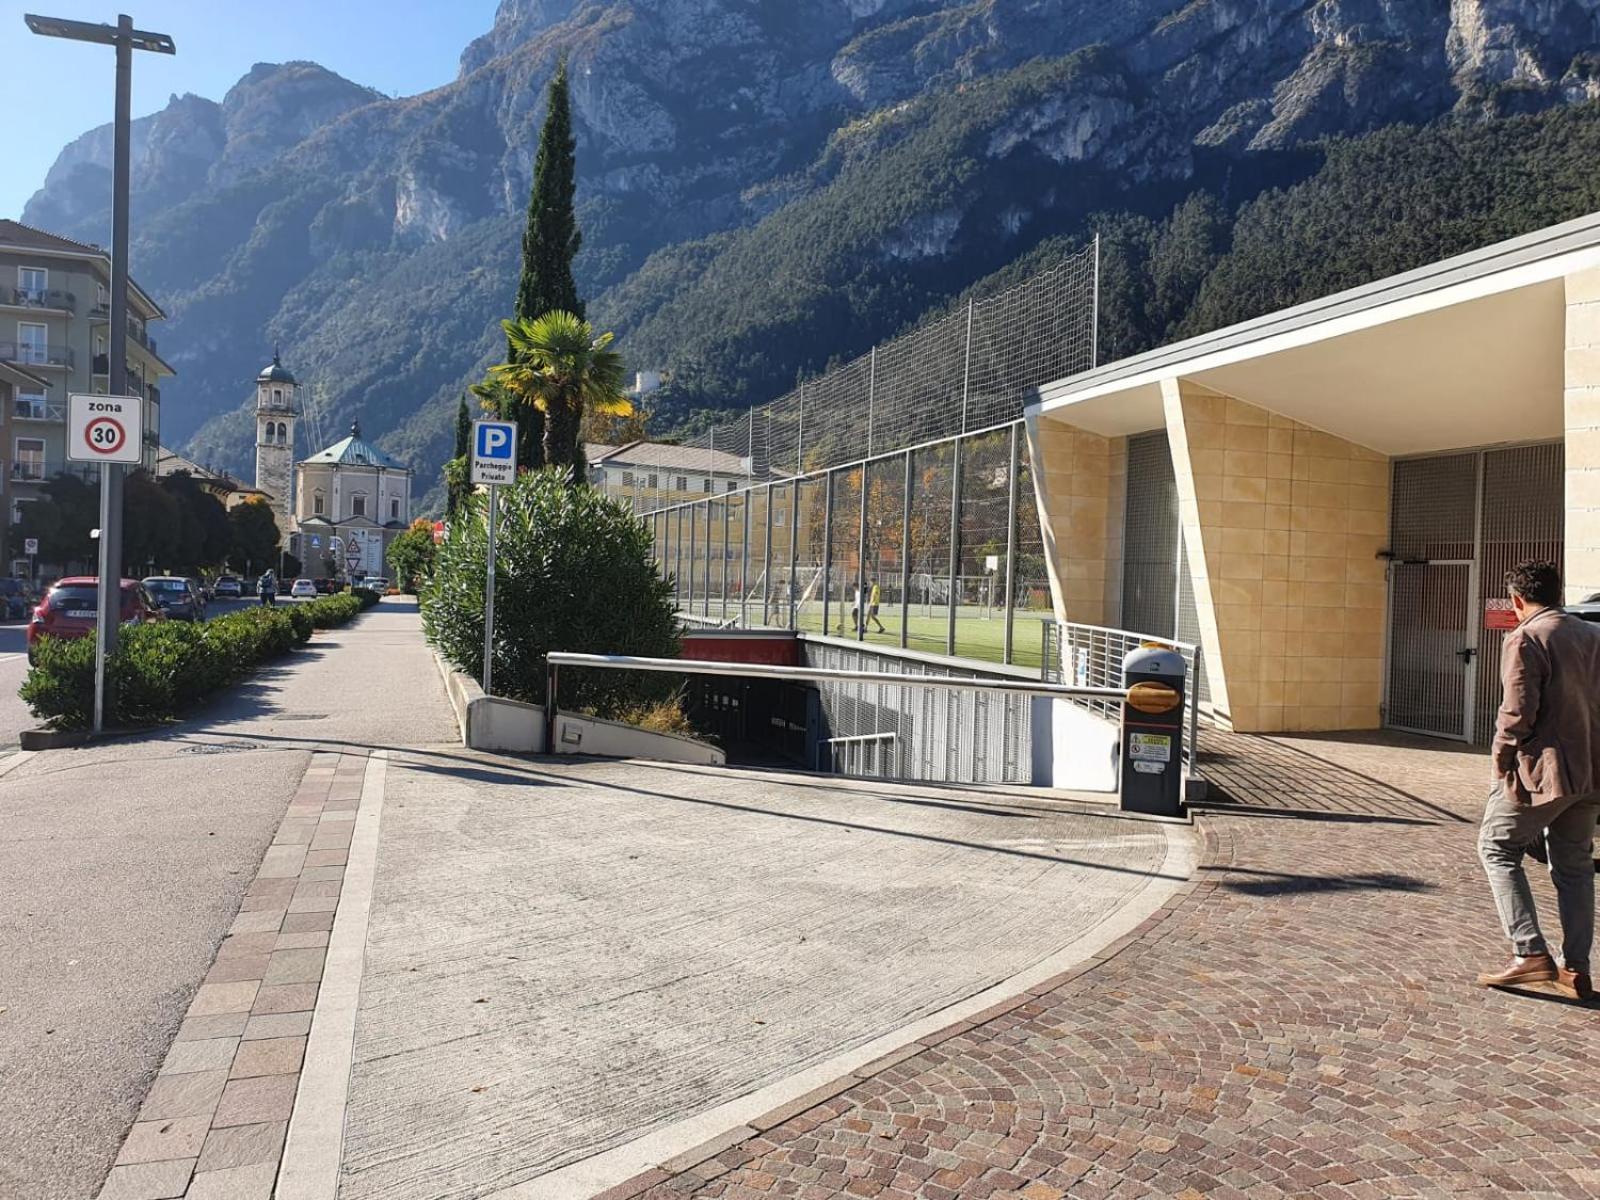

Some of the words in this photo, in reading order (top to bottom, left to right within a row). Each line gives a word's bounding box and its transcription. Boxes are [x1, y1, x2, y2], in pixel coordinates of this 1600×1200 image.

[88, 402, 122, 412] zona
[94, 427, 116, 444] 30
[485, 429, 507, 456] P
[475, 461, 512, 471] Parcheggio
